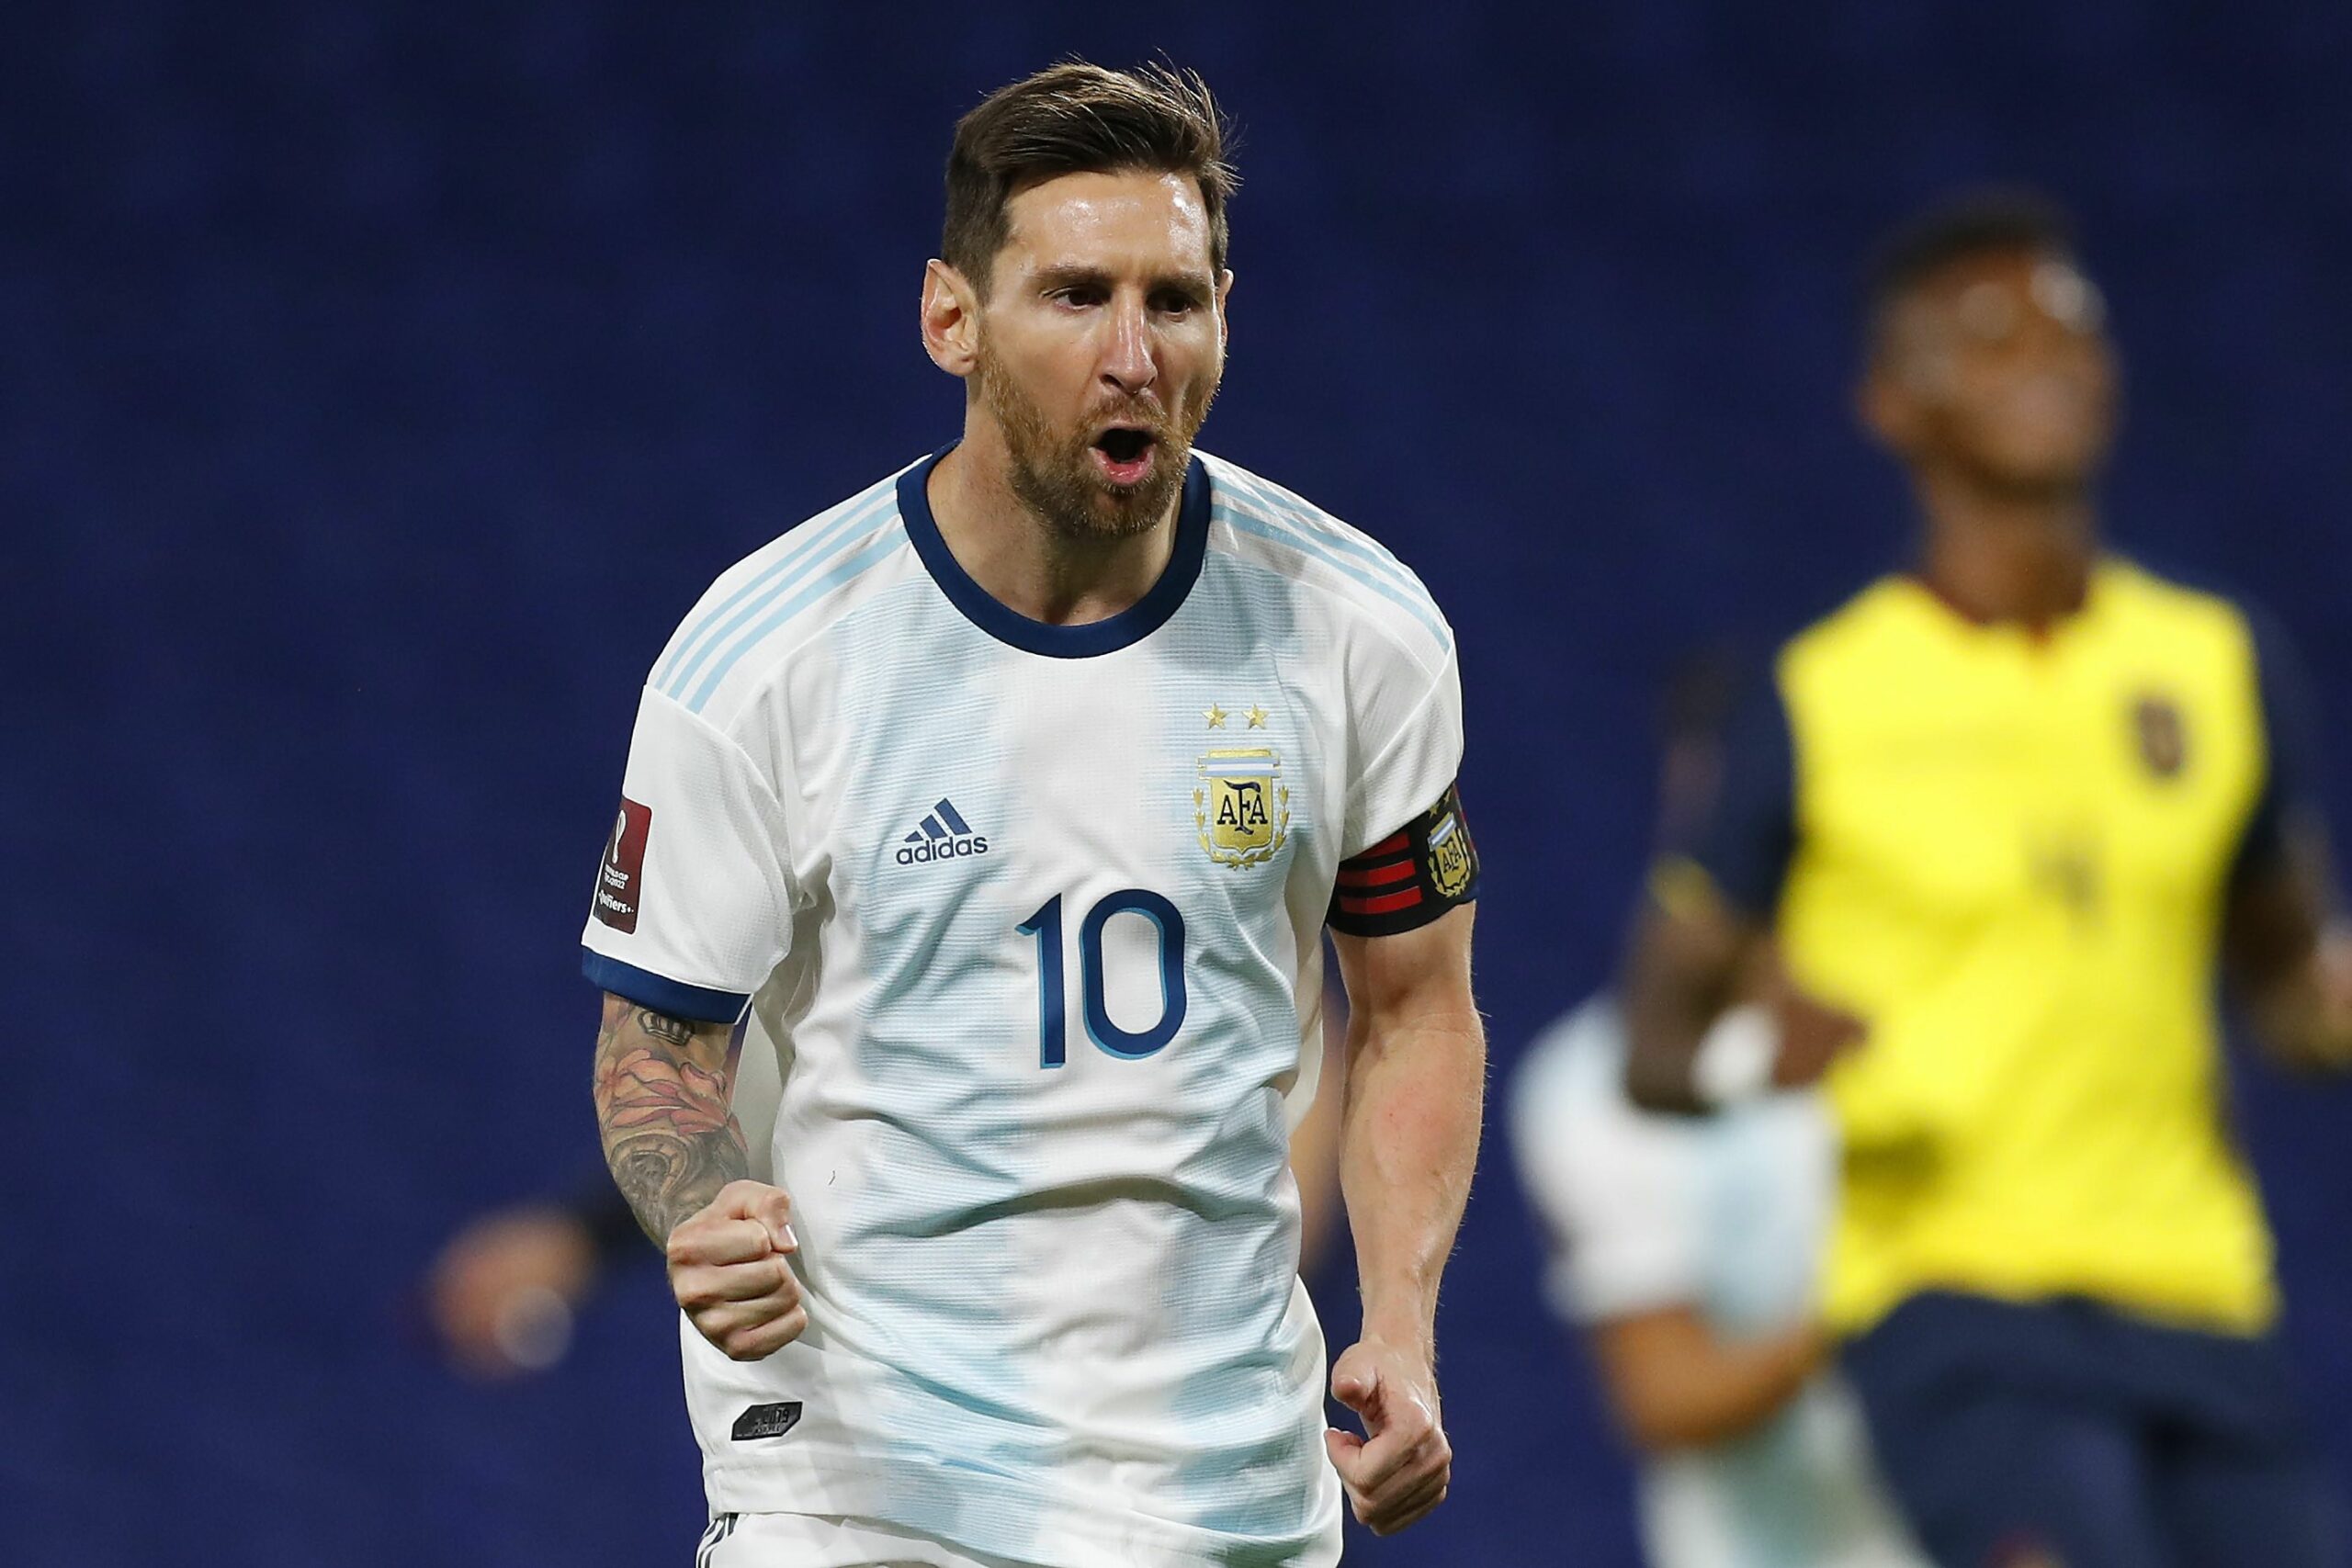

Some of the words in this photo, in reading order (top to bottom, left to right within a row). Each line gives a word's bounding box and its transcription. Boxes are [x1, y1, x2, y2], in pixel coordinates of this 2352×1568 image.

[1216, 779, 1268, 835] AFA
[896, 837, 988, 865] adidas
[1014, 888, 1188, 1069] 10
